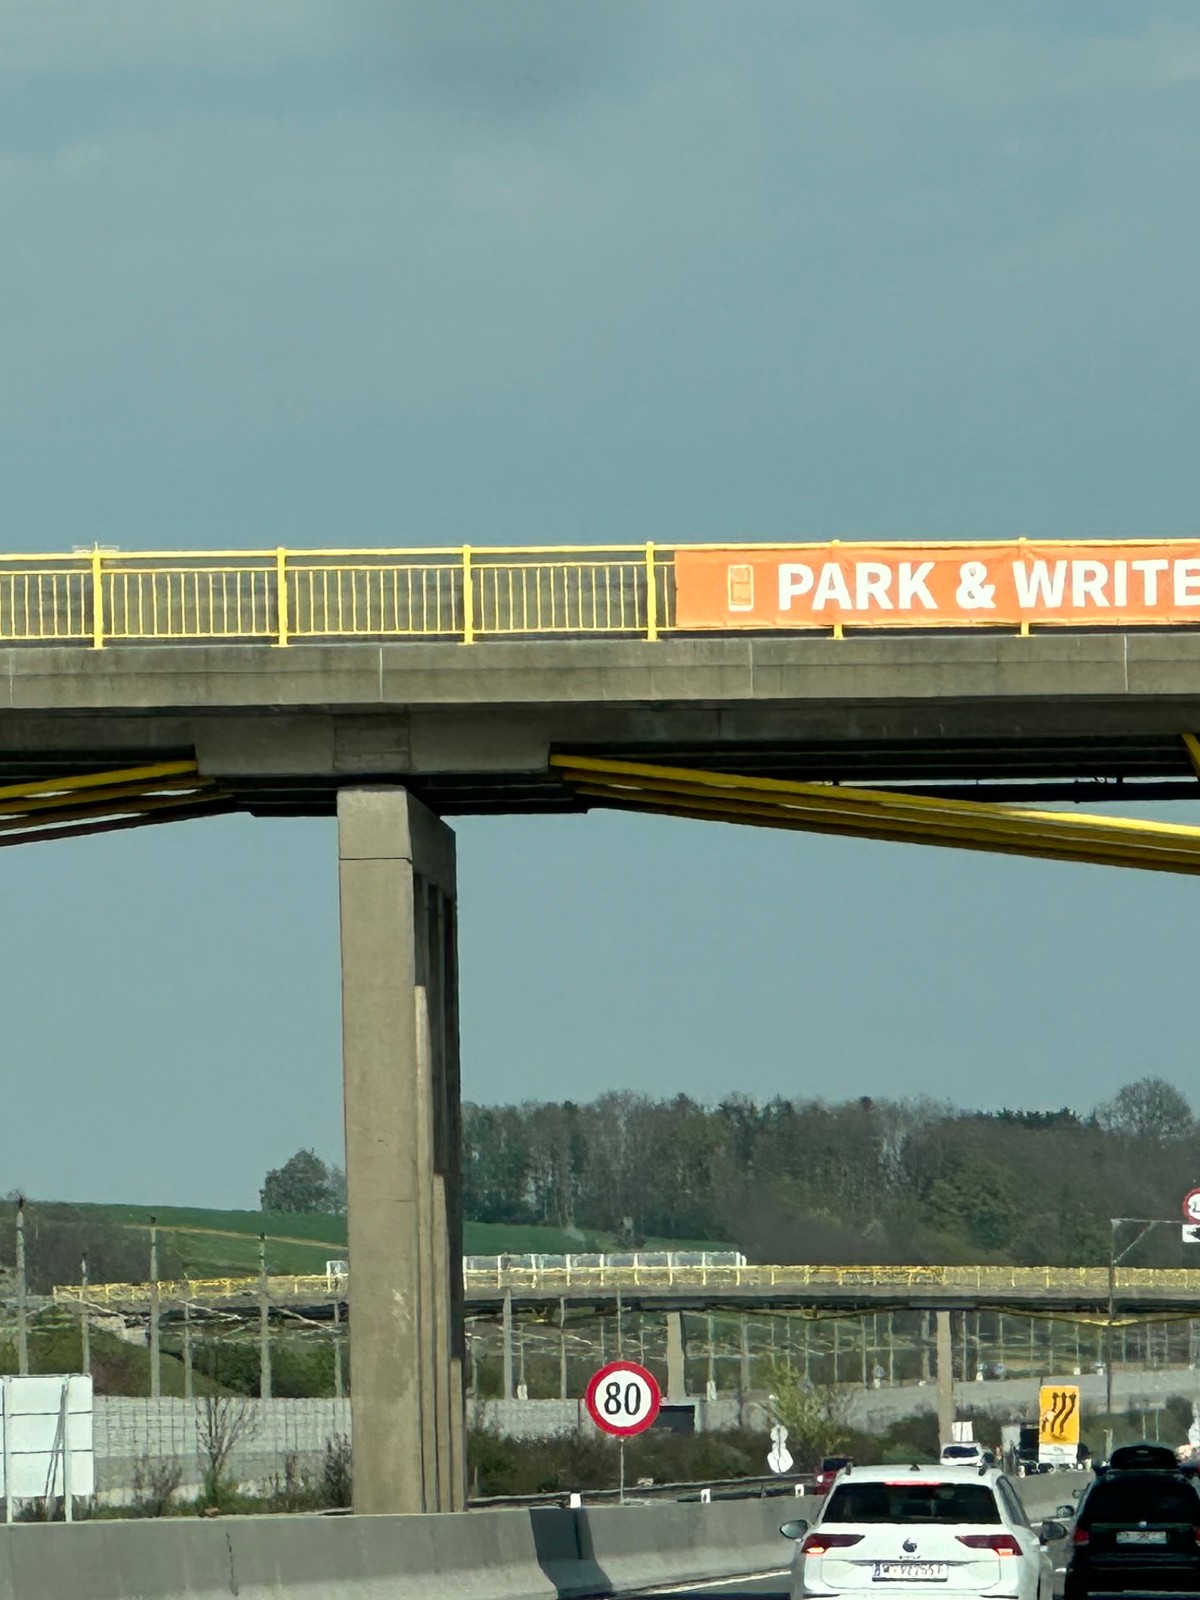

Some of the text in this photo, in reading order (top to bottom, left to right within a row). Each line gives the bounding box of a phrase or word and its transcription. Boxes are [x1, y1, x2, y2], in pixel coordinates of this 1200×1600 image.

[778, 562, 935, 611] PARK
[955, 560, 996, 609] &
[604, 1381, 642, 1416] 80
